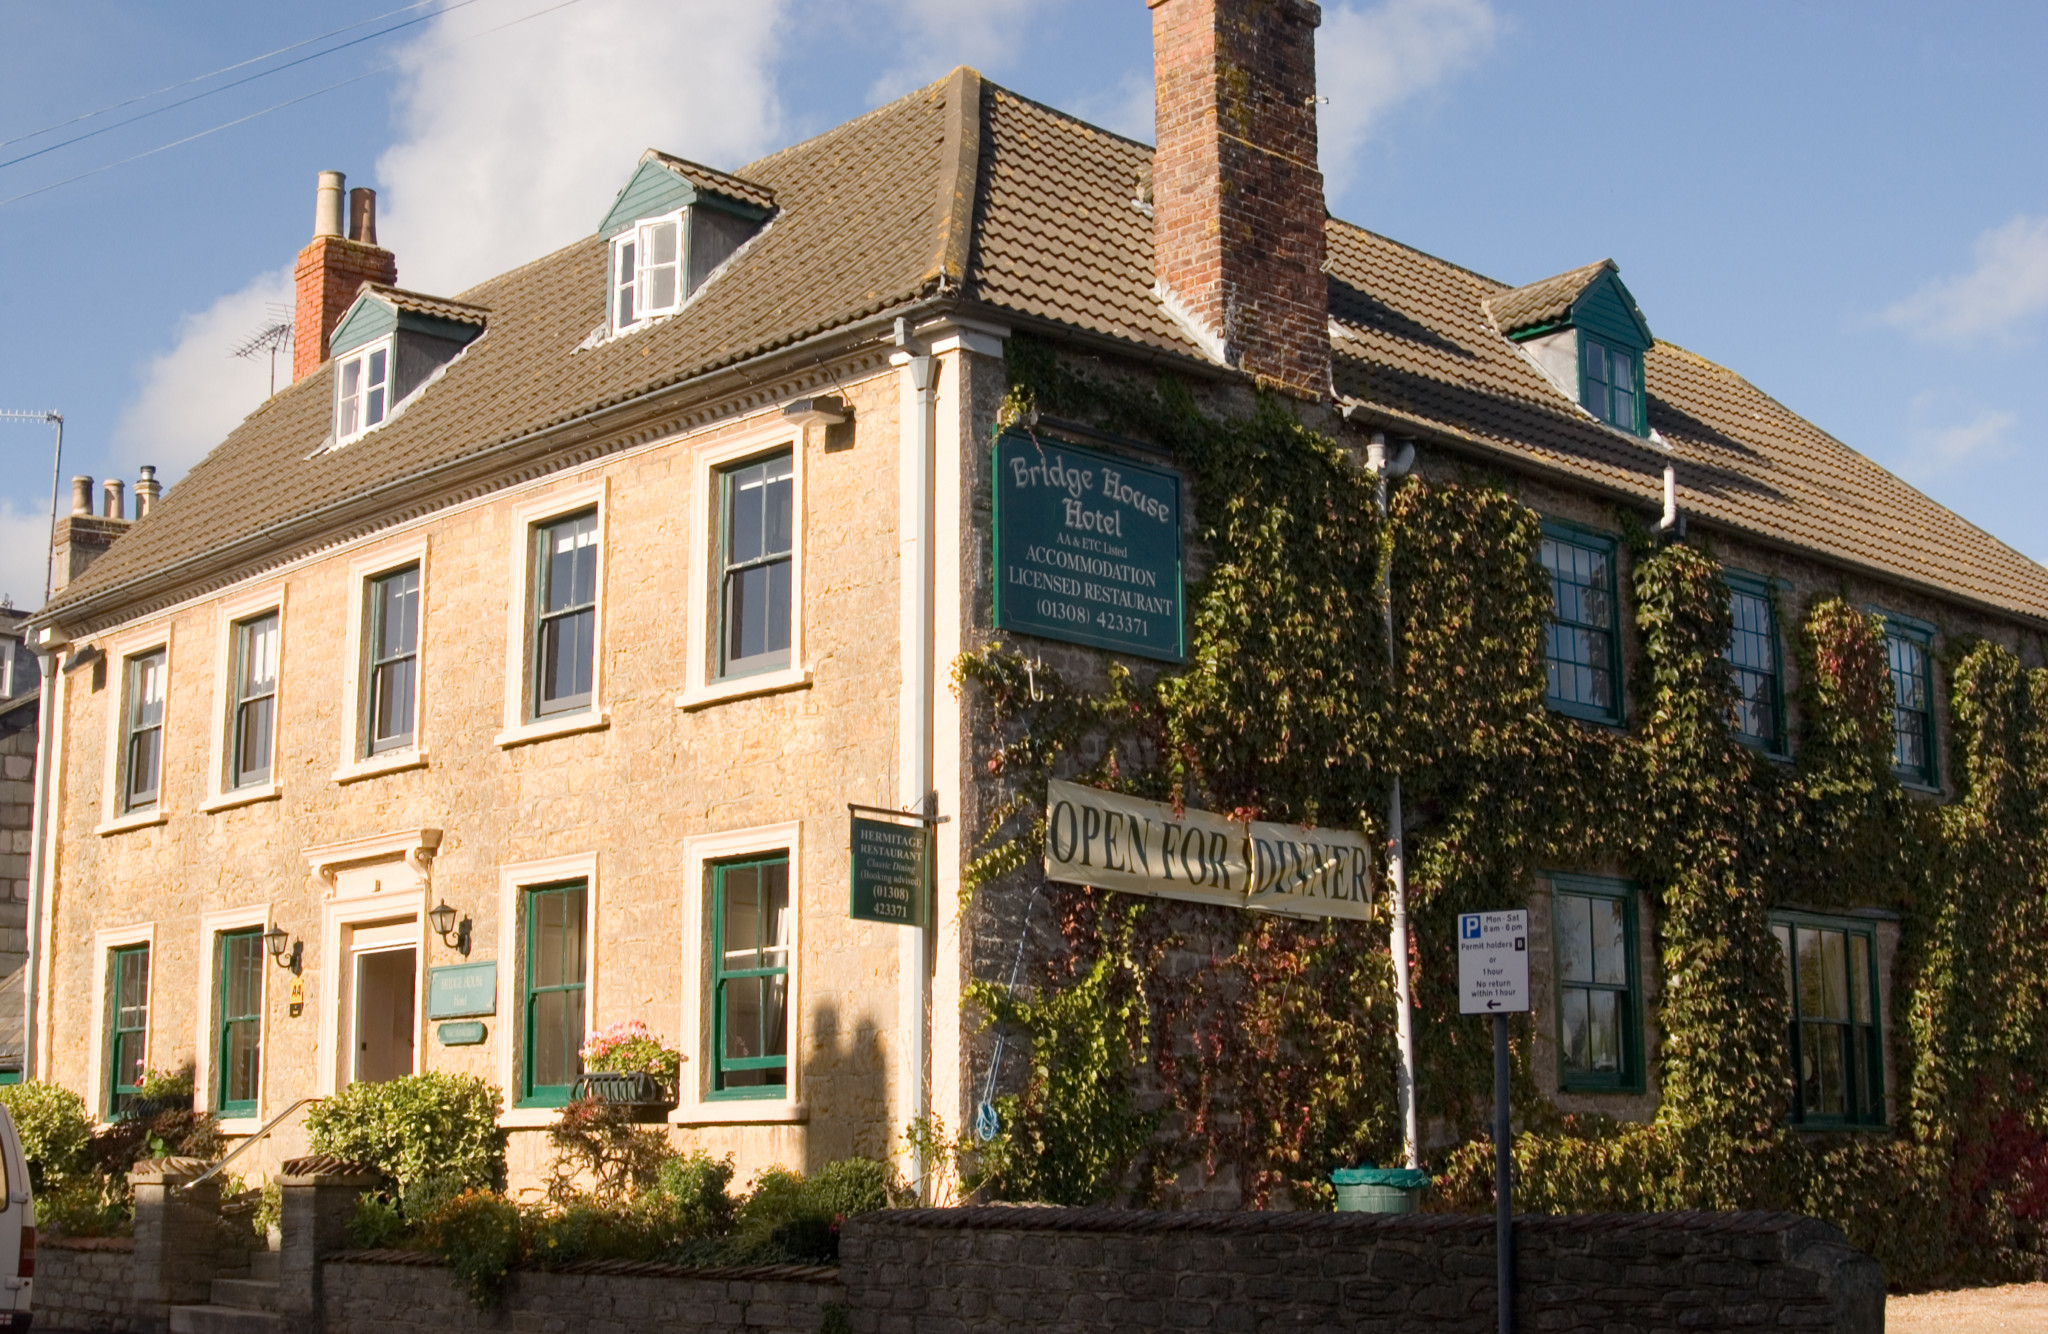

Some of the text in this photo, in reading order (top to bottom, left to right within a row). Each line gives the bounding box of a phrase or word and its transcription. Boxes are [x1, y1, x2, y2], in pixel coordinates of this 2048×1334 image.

[1009, 455, 1170, 523] Bridge House
[1062, 498, 1122, 538] Hotel
[1057, 532, 1128, 558] AA & ETC Listed
[1025, 544, 1156, 588] ACCOMMODATION
[1009, 566, 1173, 616] LICENSED RESTAURANT
[1037, 598, 1148, 637] (01308) 423371
[861, 829, 923, 849] HERMITAGE
[860, 844, 923, 862] RESTAURANT
[1051, 800, 1151, 878] OPEN
[1161, 820, 1231, 891] FOR
[1254, 837, 1370, 904] DINNER
[866, 857, 916, 875] Classic Dining
[860, 869, 893, 884] (Booking
[873, 885, 909, 903] (01308)
[873, 902, 907, 918] 423371
[1466, 917, 1480, 938] P
[1486, 915, 1502, 924] Mon
[1506, 914, 1519, 922] Sat
[1511, 924, 1523, 932] pm
[1461, 942, 1484, 951] Permit
[1486, 940, 1513, 949] holders
[1487, 967, 1504, 976] hour
[1471, 989, 1493, 998] within
[1499, 988, 1516, 996] hour
[1476, 980, 1511, 988] No return
